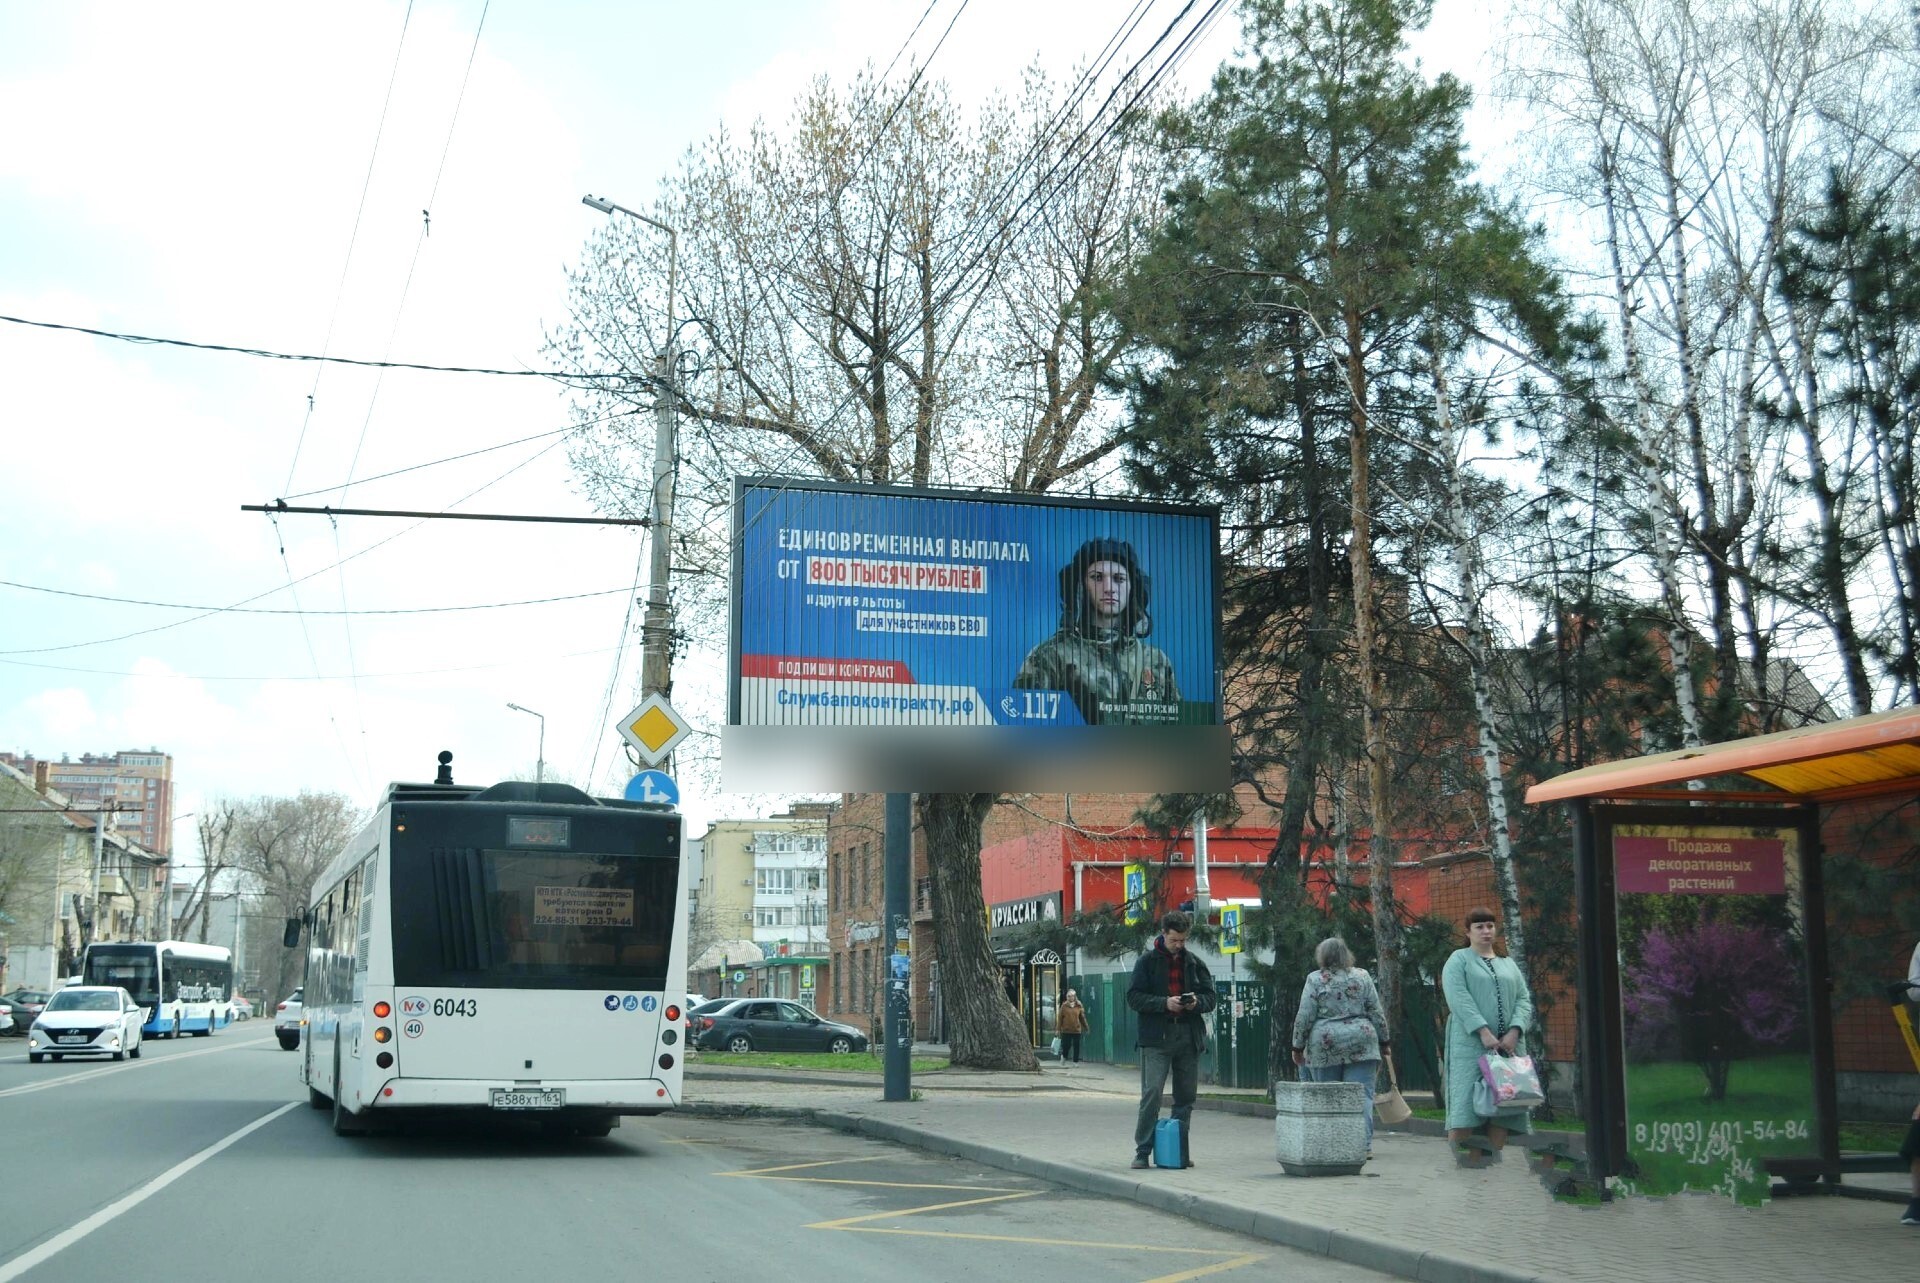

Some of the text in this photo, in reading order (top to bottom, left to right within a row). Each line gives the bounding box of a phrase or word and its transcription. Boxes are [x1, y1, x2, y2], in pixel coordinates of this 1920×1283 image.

[778, 528, 1030, 562] ЕДИНОВРЕМЕННАЯ ВЫПЛАТА
[777, 559, 982, 589] ОТ 800 ТЫСЯЧ РУБЛЕЙ
[806, 594, 906, 610] и другие льготы
[861, 616, 981, 632] для участников СВО
[778, 661, 895, 679] ПОДПИШИ КОНТРАКТ
[778, 689, 975, 716] Службапоконтракту.рф
[1022, 692, 1061, 719] 117
[1667, 838, 1732, 855] Продажа
[1648, 859, 1753, 873] декоративных
[1668, 876, 1736, 891] растений
[991, 900, 1037, 929] КРУАССАН
[433, 998, 478, 1018] 6043
[407, 1023, 421, 1034] 40
[1635, 1122, 1647, 1144] 8
